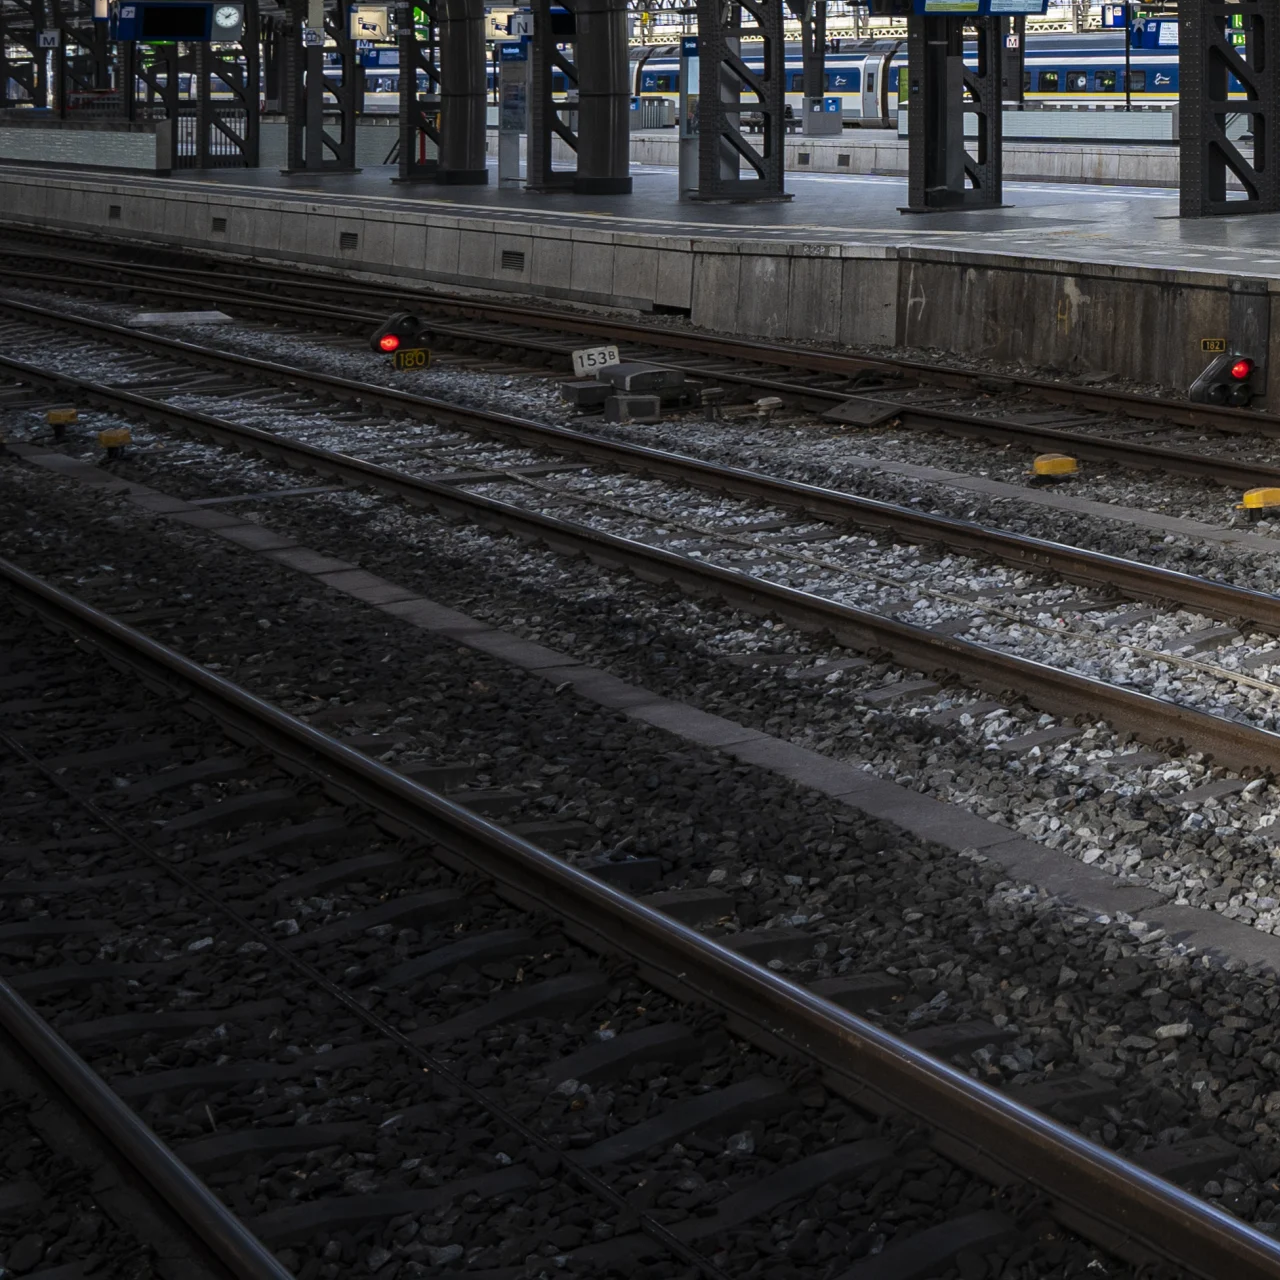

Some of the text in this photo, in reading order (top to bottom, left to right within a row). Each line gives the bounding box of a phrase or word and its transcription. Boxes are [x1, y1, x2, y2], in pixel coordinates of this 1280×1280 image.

[517, 22, 528, 33] N
[42, 36, 56, 46] M
[1008, 38, 1017, 47] M
[1206, 341, 1220, 350] 182
[400, 351, 425, 367] 180
[578, 350, 616, 368] 153B
